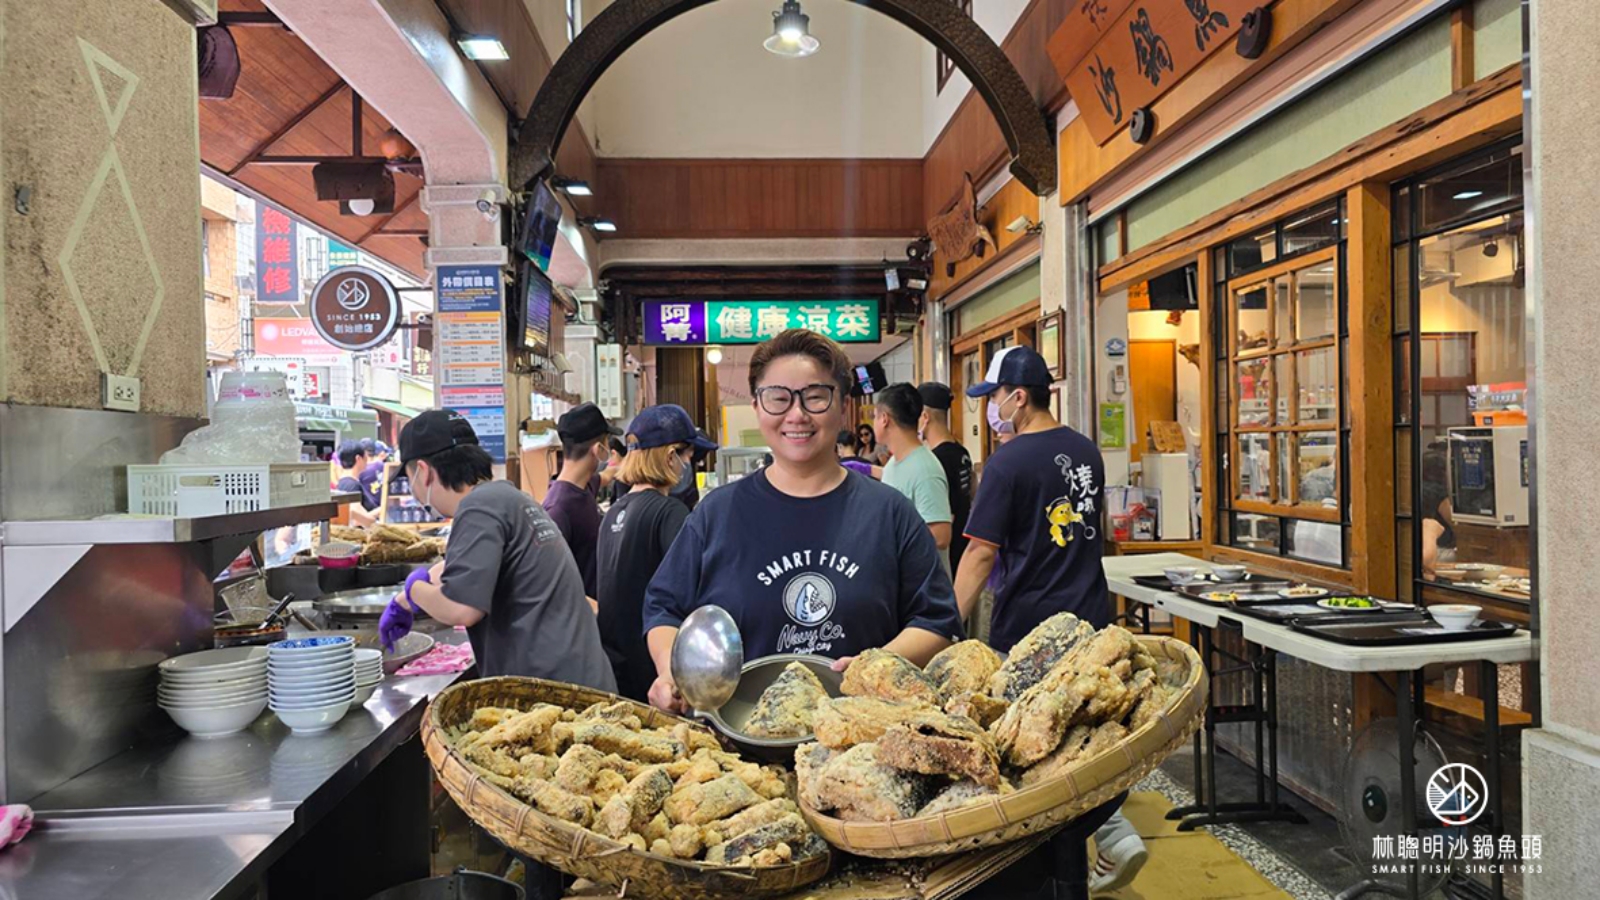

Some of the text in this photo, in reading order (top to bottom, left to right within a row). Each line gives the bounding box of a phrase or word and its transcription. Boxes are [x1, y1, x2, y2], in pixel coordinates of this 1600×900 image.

[715, 304, 871, 339] 健康涼菜
[757, 549, 860, 586] SMART FISH
[776, 621, 846, 653] Navy Co.
